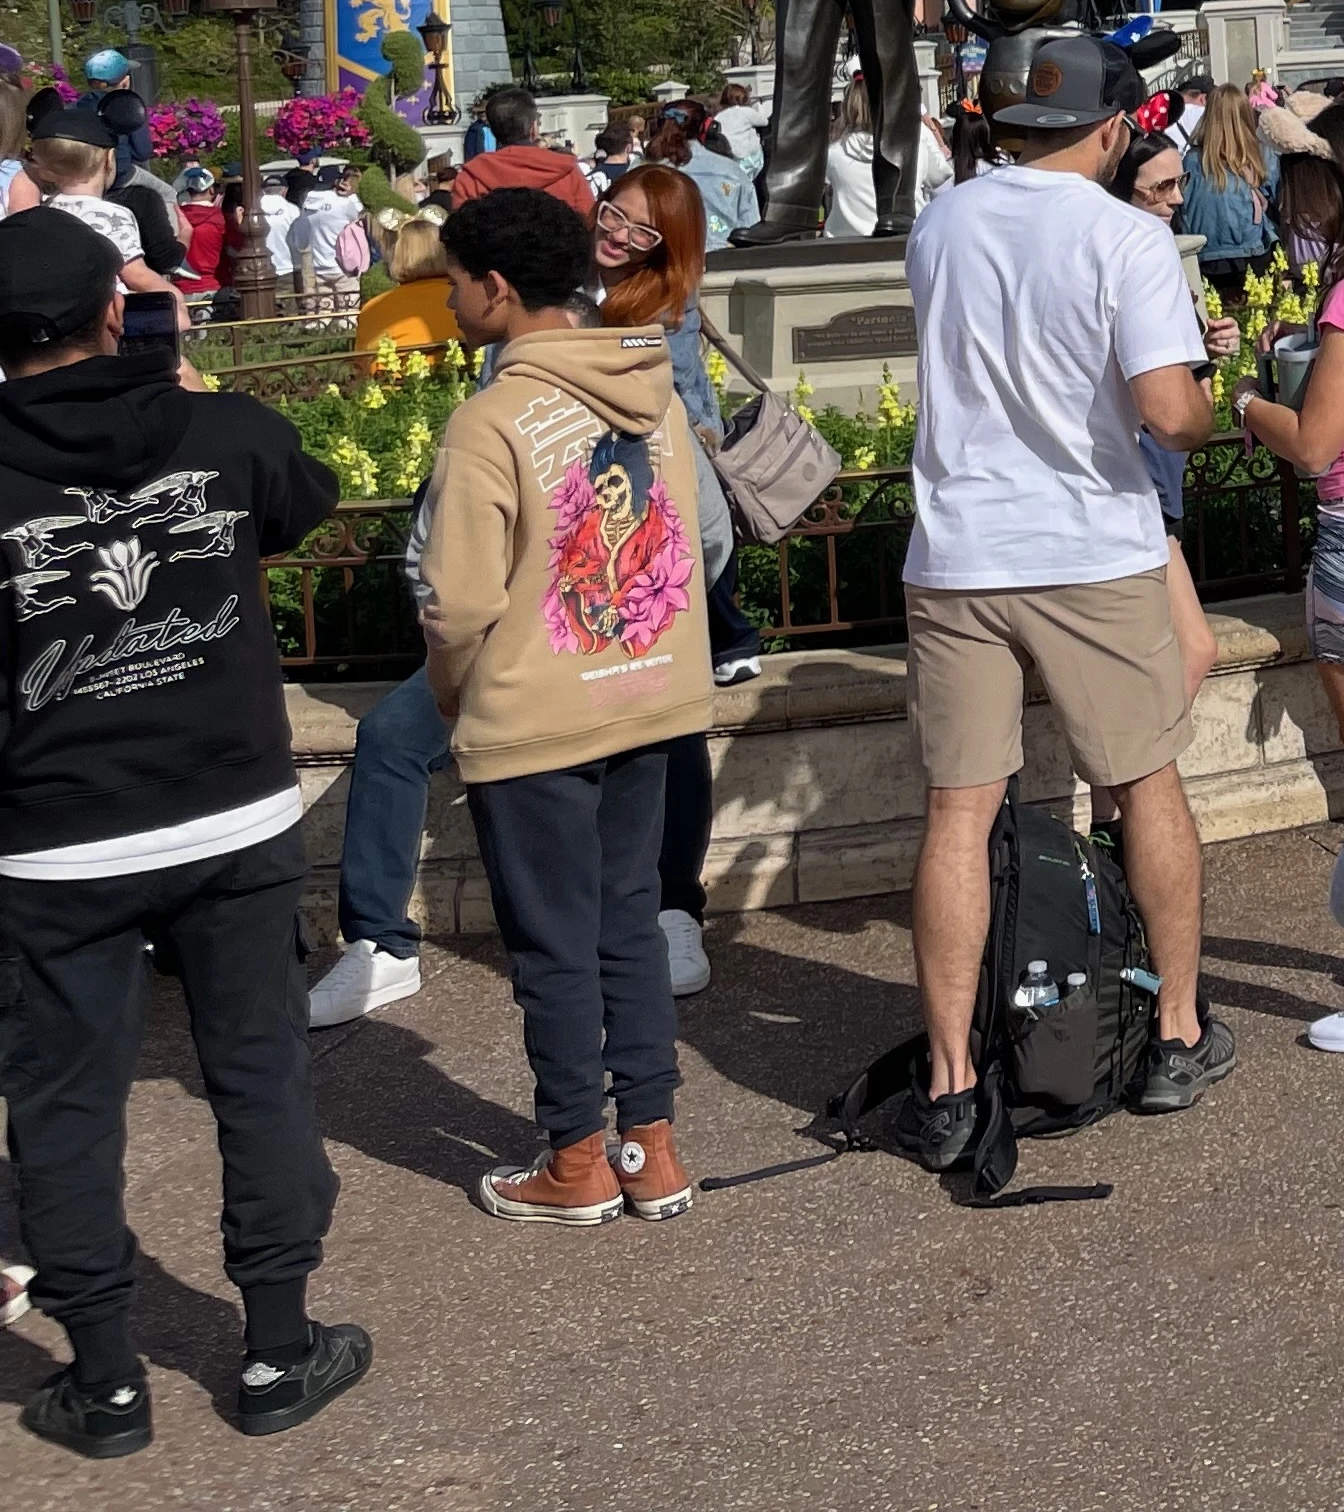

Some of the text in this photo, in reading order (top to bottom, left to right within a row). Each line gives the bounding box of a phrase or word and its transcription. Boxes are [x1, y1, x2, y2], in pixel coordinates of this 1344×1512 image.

[140, 668, 159, 680] LOS
[160, 656, 206, 674] ANGELES
[96, 671, 186, 700] CALIFORNIA STATE
